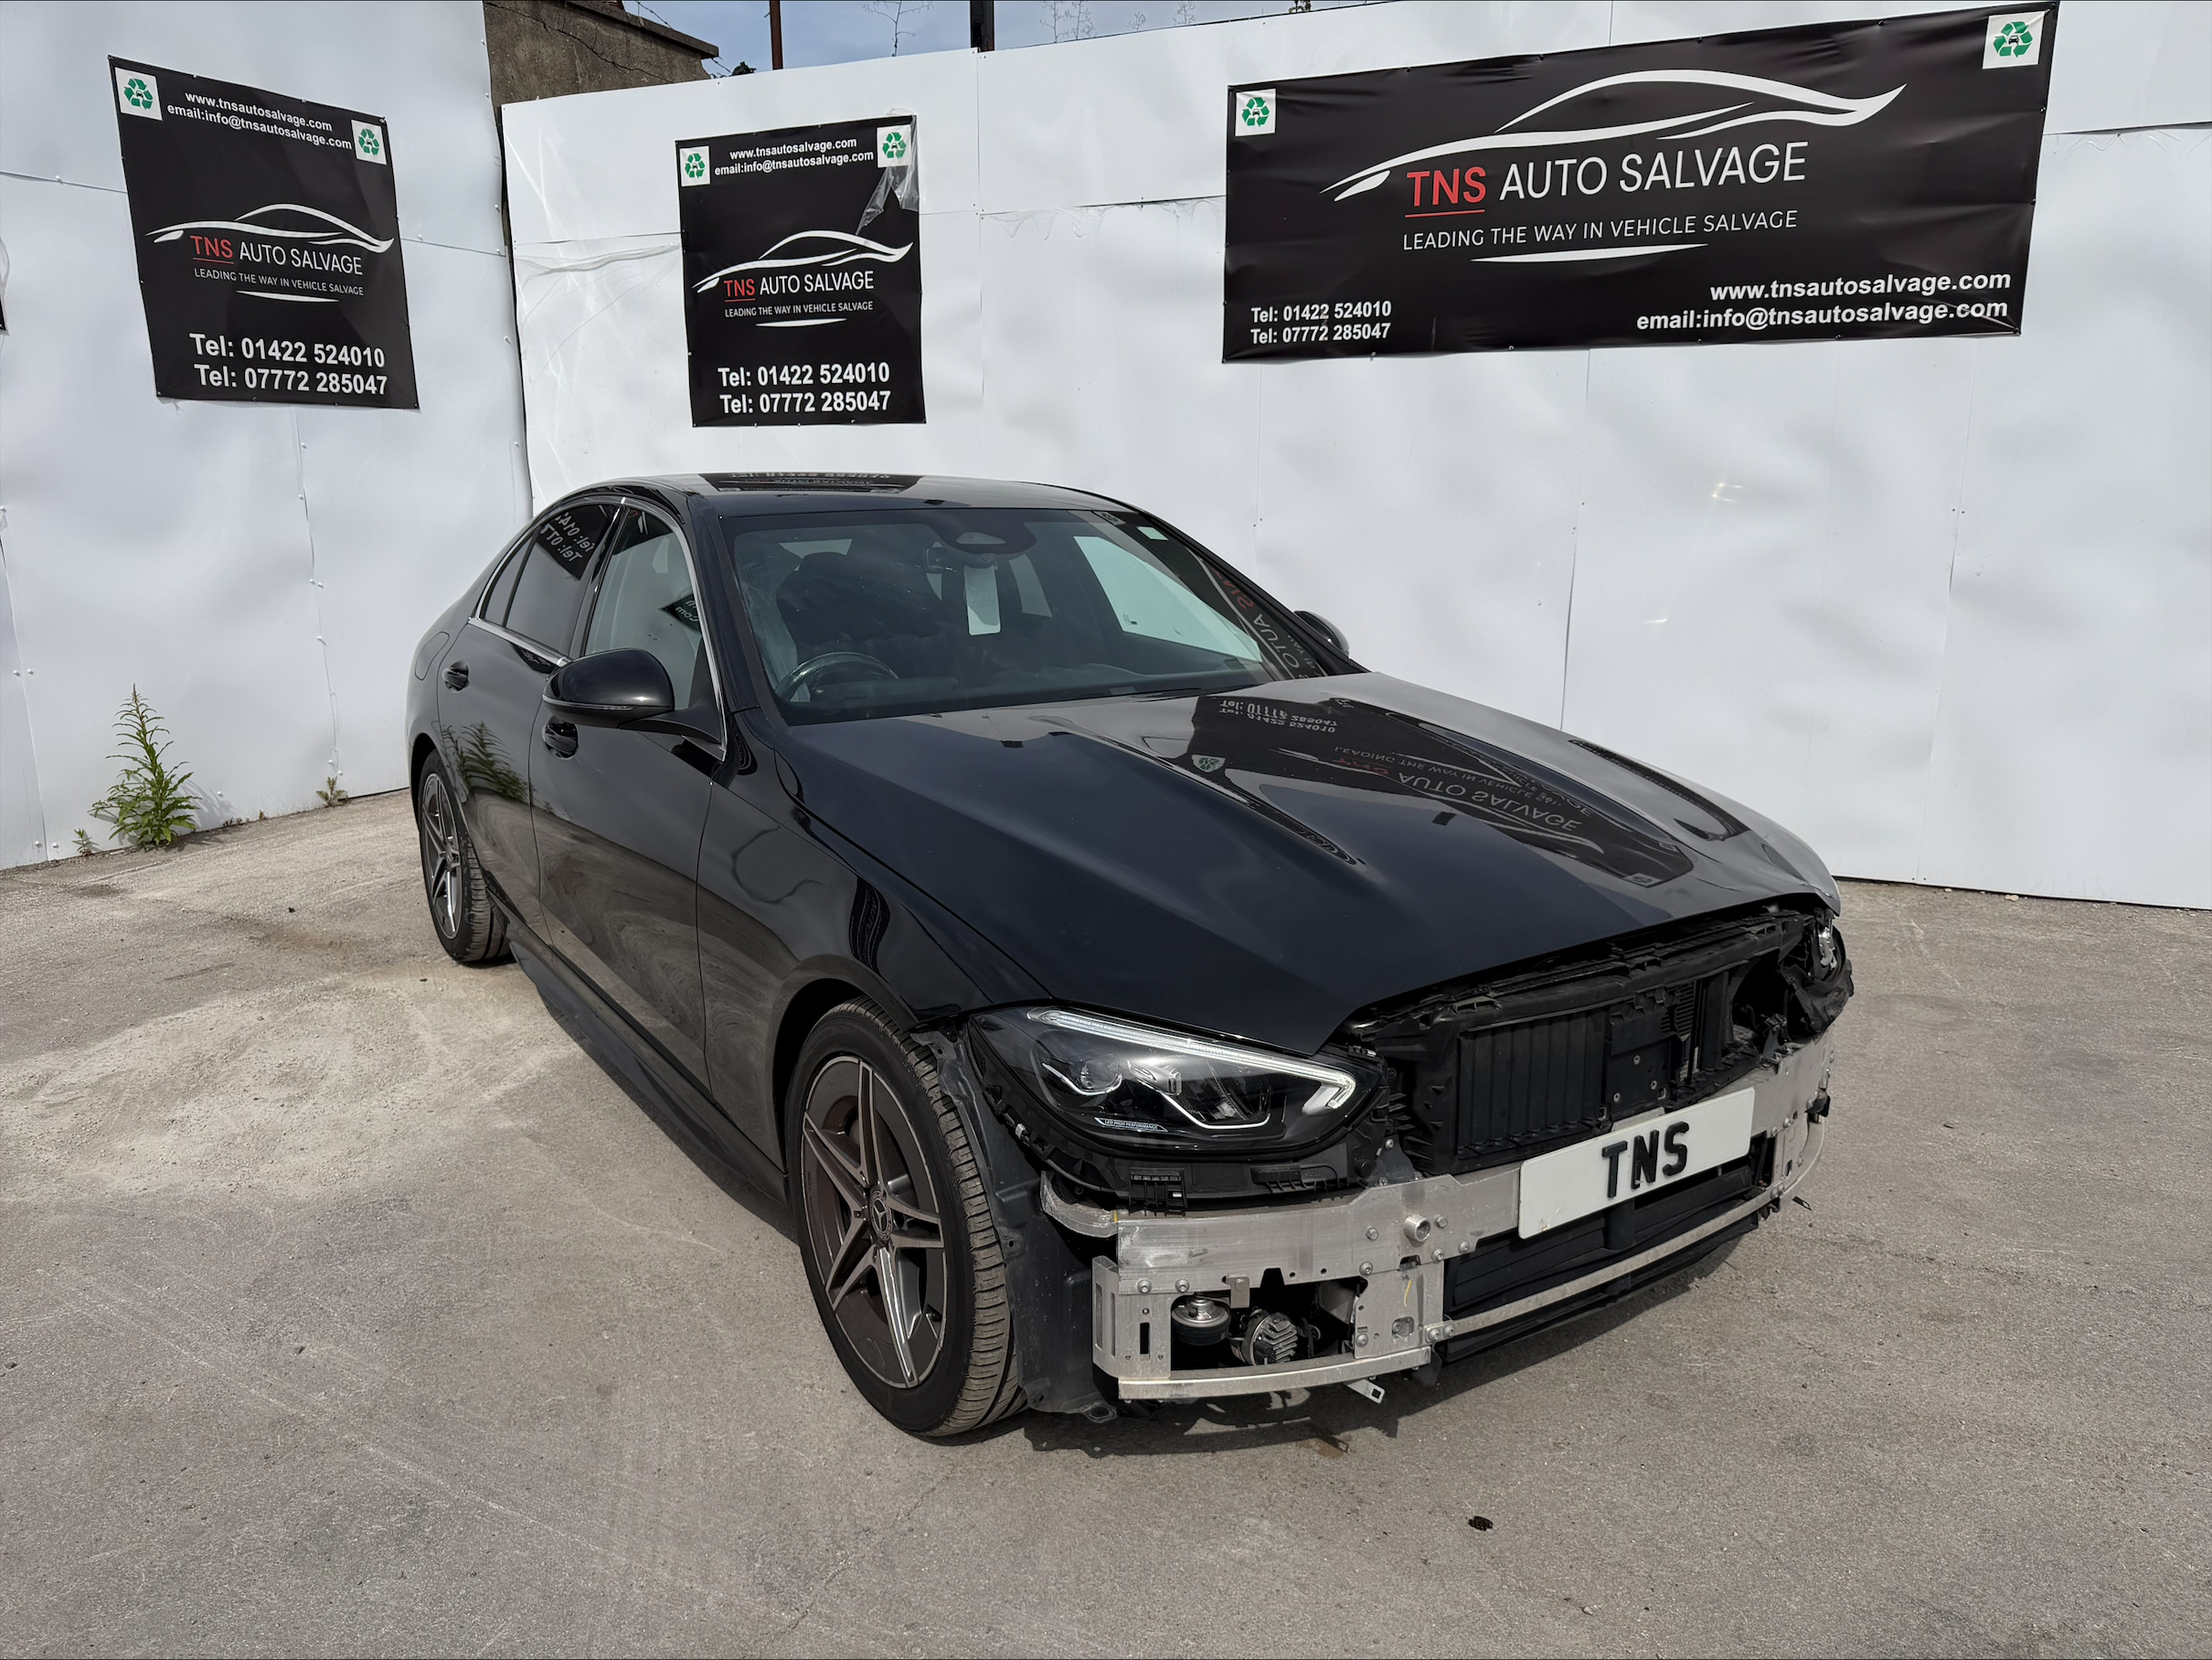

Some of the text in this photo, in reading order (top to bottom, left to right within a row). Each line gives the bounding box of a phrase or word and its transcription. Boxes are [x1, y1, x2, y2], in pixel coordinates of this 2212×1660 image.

[185, 92, 333, 132] www.tnsautosalvage.com
[167, 105, 352, 150] email:info@tnsautosalvage.com
[729, 139, 856, 160] www.tnsautosalvage.com
[715, 152, 874, 176] email:info@tnsautosalvage.com
[1407, 142, 1808, 207] TNS AUTO SALVAGE
[1404, 210, 1797, 250] LEADING THE WAY IN VEHICLE SALVAGE
[190, 236, 363, 275] TNS AUTO SALVAGE
[195, 268, 364, 295] LEADING THE WAY IN VEHICLE SALVAGE
[724, 271, 874, 297] TNS AUTO SALVAGE
[1710, 274, 2011, 300] www.tnsautosalvage.com
[725, 301, 873, 317] LEADING THE WAY IN VEHICLE SALVAGE
[1250, 301, 1391, 323] Tel: 01422 524010
[1637, 303, 2007, 330] email:info@tnsautosalvage.com
[1250, 323, 1391, 344] Tel: 07772 285047
[189, 333, 385, 367] Tel: 01422 524010
[194, 364, 388, 395] Tel: 07772 285047
[718, 362, 889, 387] Tel: 01422 524010
[719, 390, 891, 413] Tel: 07772 285047
[1601, 1121, 1690, 1198] TNS
